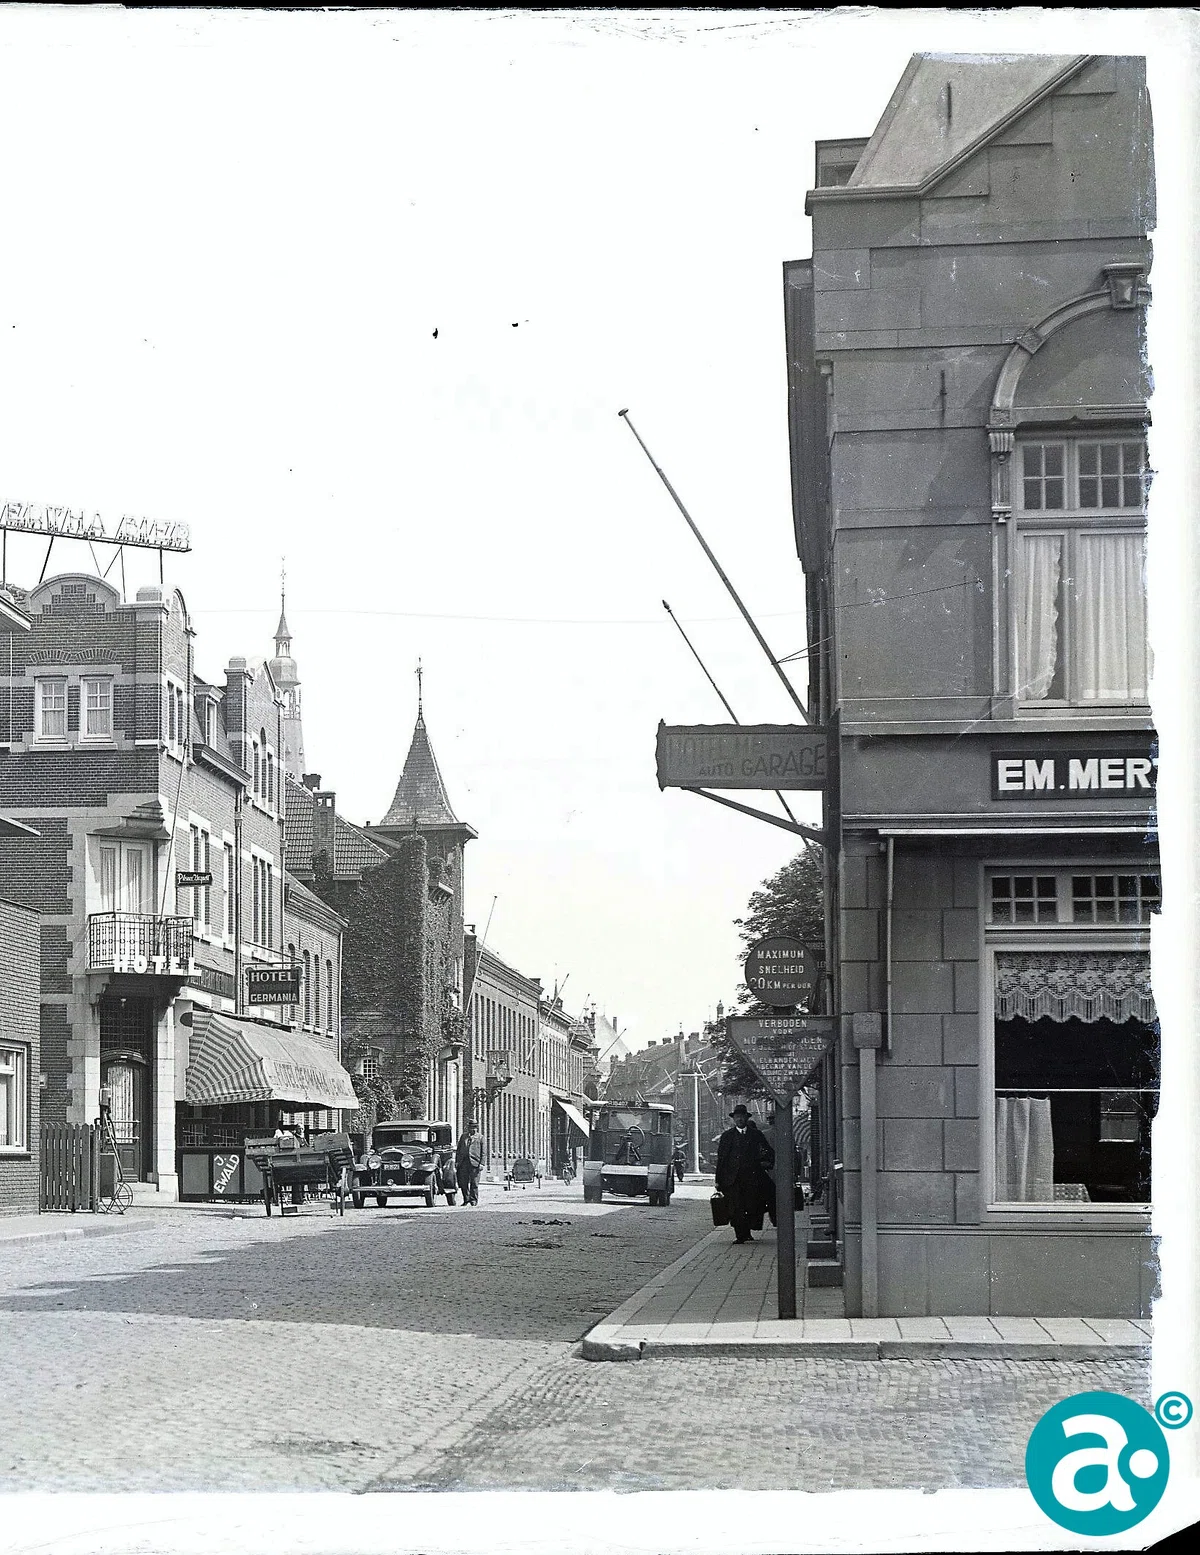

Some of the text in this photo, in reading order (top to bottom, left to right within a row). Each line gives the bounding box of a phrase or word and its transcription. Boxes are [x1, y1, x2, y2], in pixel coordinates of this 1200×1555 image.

[741, 742, 826, 777] GARAGE
[757, 950, 804, 959] MAXIMUM
[113, 954, 202, 977] HOTEL
[759, 965, 804, 974] SNELHEID
[251, 971, 297, 982] HOTEL
[250, 993, 298, 1002] GERMANIA
[758, 1019, 807, 1028] VERBODEN
[213, 1154, 240, 1194] EWALD
